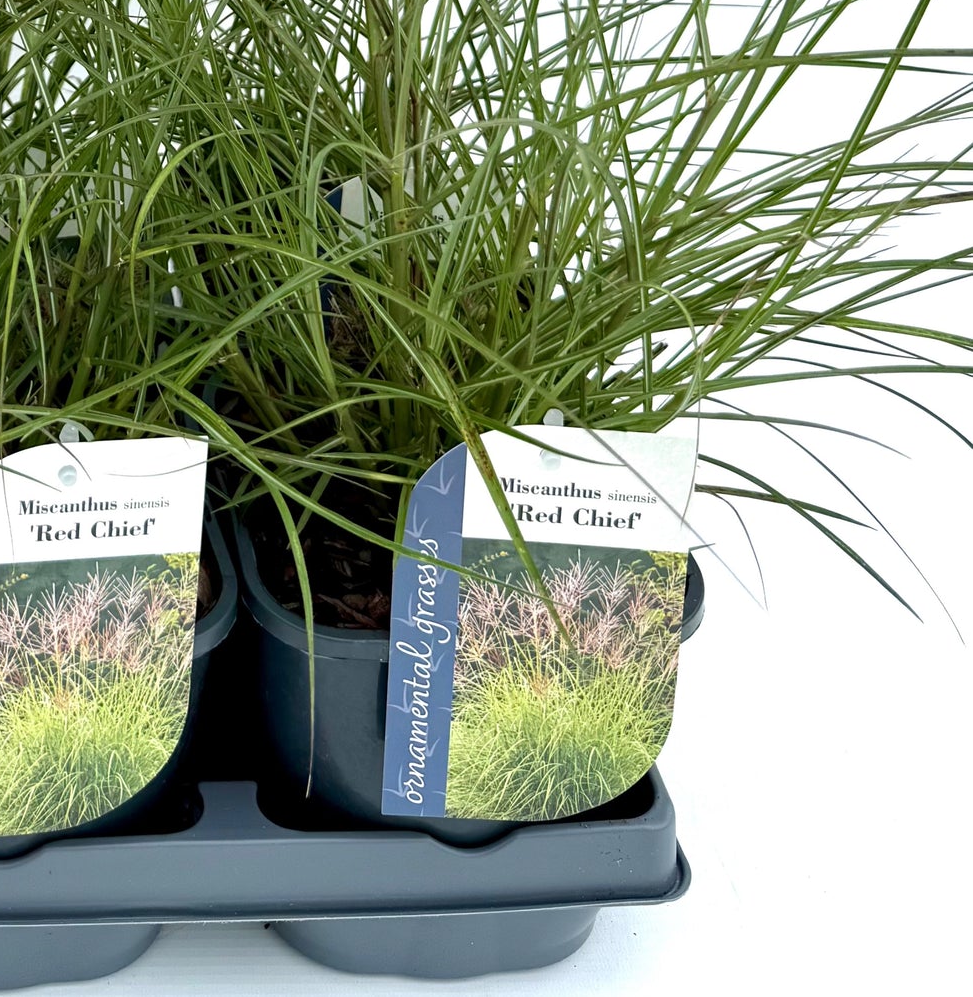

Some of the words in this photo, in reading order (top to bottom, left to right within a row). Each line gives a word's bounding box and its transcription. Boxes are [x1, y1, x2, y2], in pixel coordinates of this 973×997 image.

[18, 497, 118, 516] Miscanthus
[123, 497, 170, 510] sinensis
[607, 490, 658, 504] sinensis
[30, 522, 81, 542] 'Red
[90, 517, 156, 539] Chief'
[572, 507, 642, 530] Chief'
[396, 640, 432, 804] ornamental
